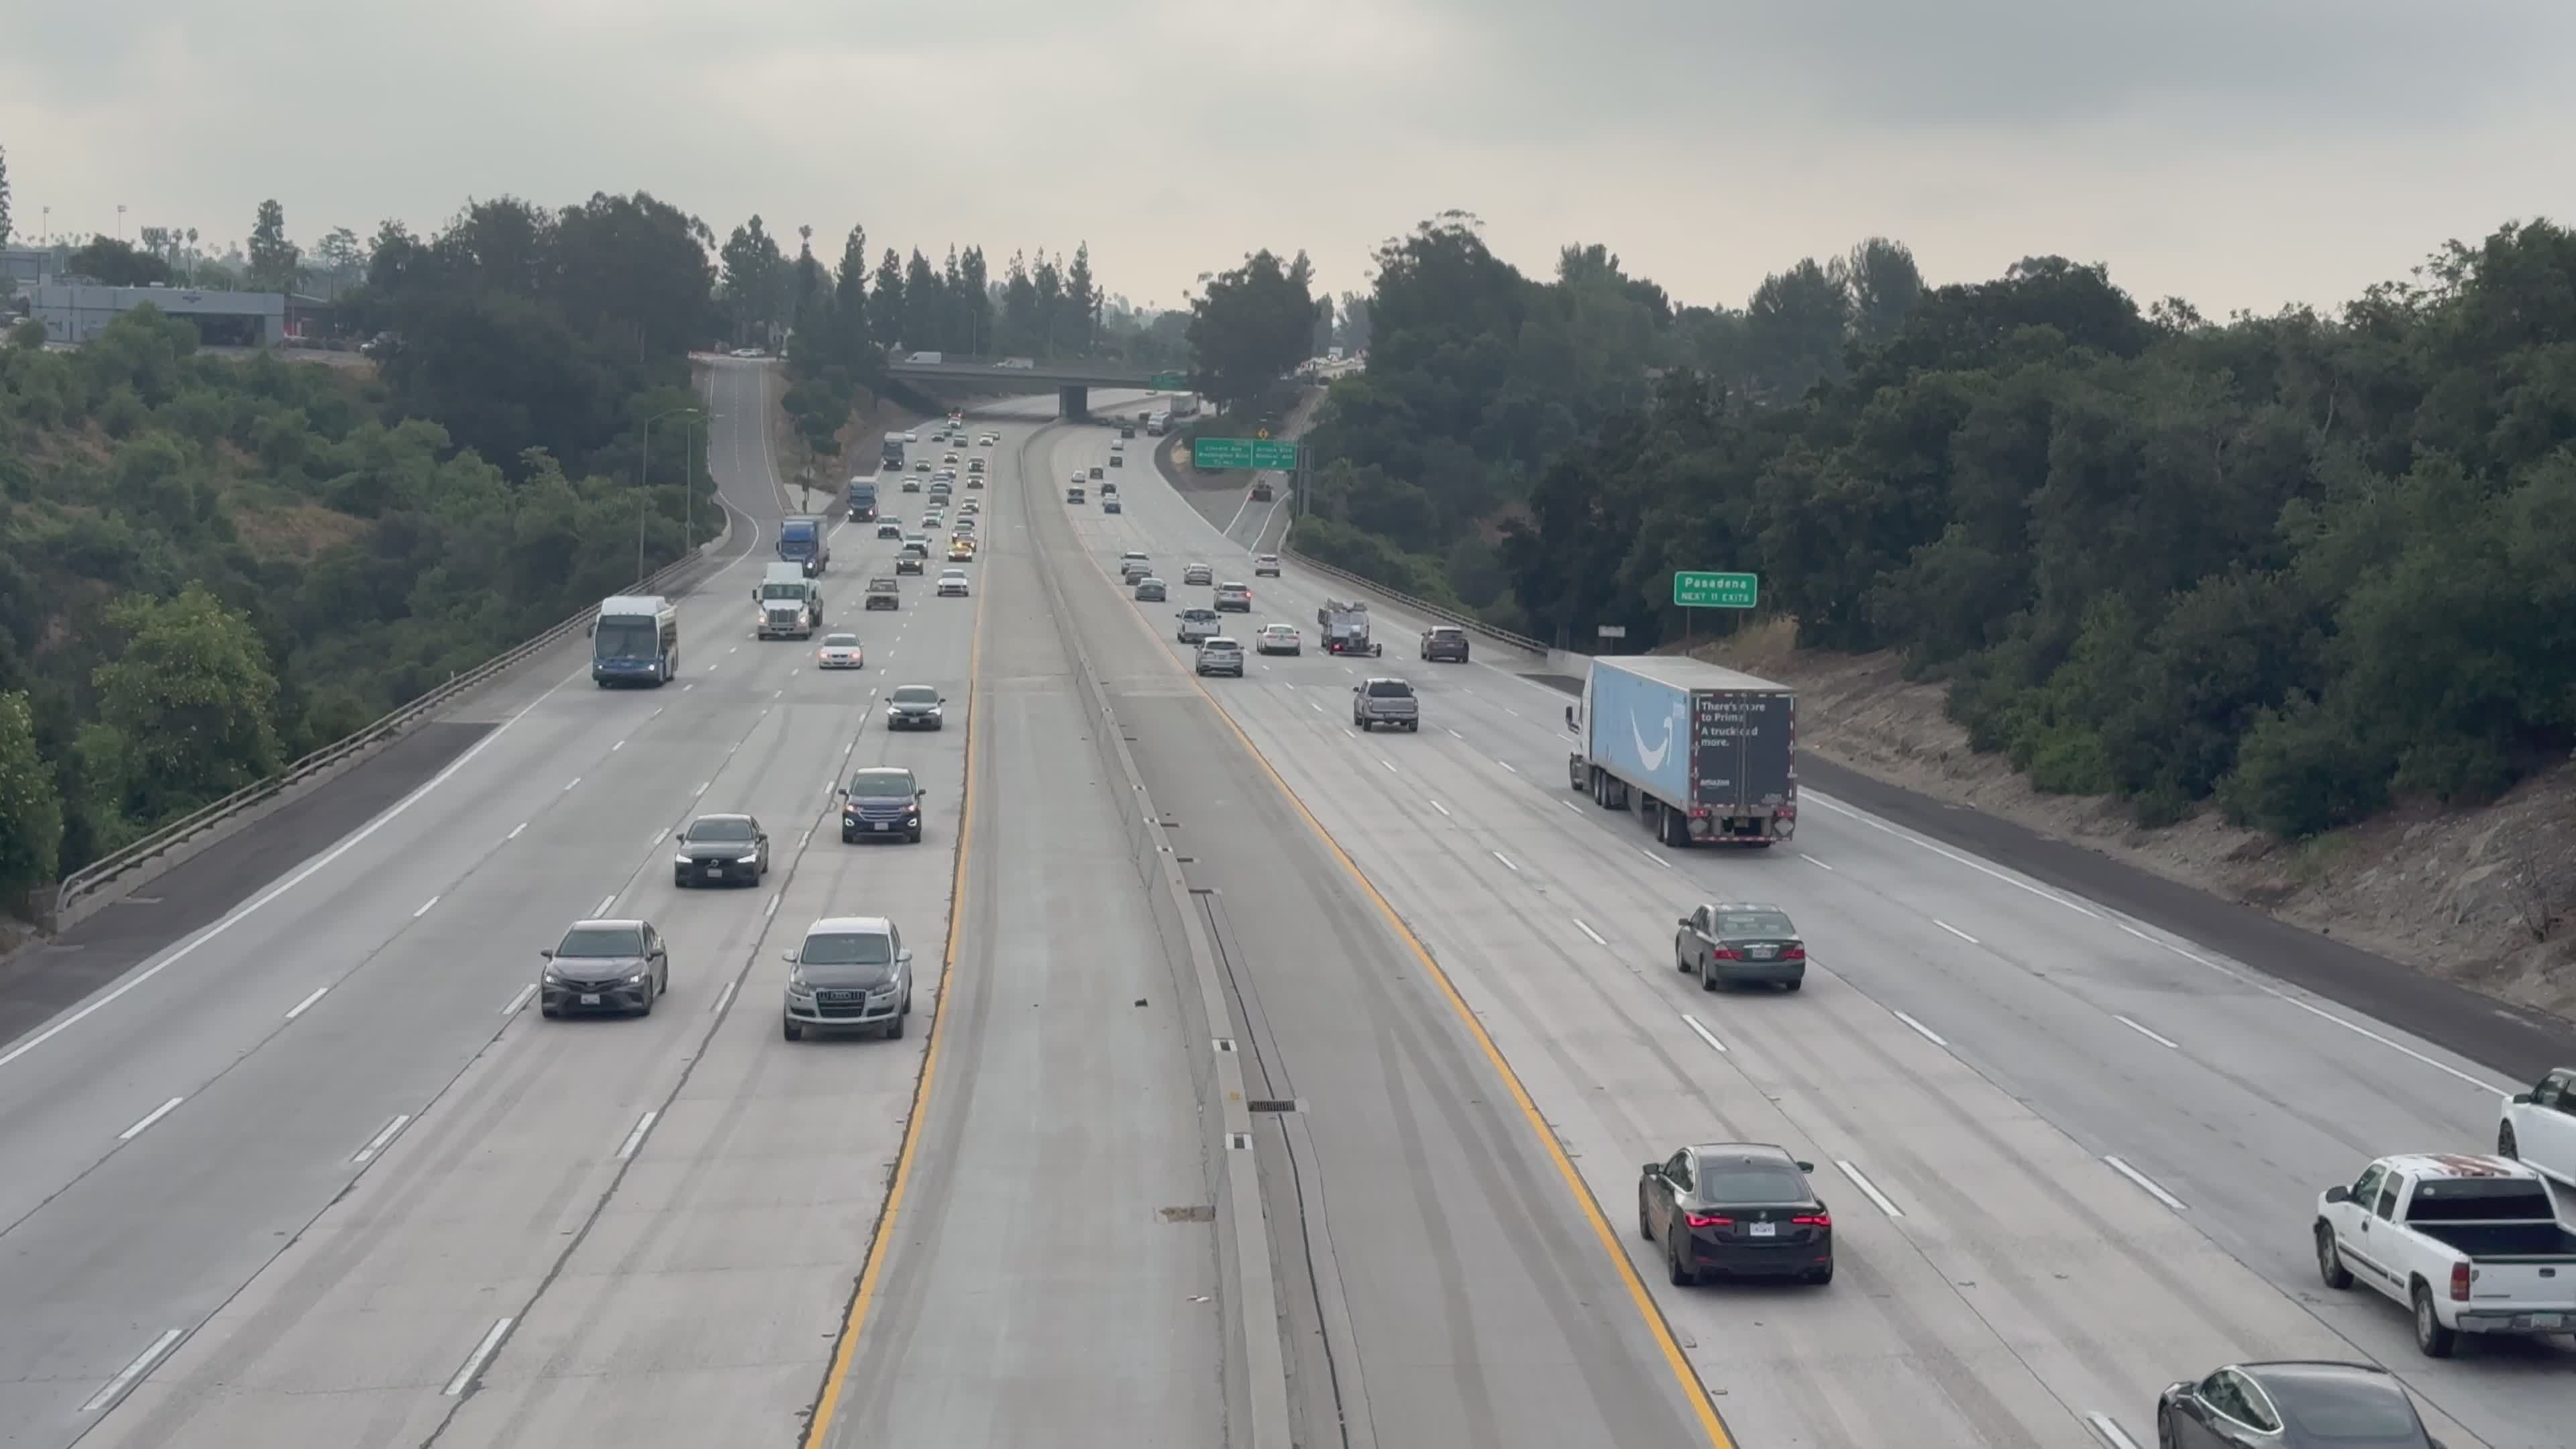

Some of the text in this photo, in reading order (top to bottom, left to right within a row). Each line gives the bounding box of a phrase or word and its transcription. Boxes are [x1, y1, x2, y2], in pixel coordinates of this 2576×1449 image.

[1684, 578, 1747, 590] Pasadena
[1681, 592, 1706, 601] NEXT
[1722, 593, 1750, 602] EXITS
[1701, 701, 1737, 712] There's
[1701, 713, 1712, 722] to
[1701, 727, 1709, 736] A
[1701, 739, 1730, 747] more.
